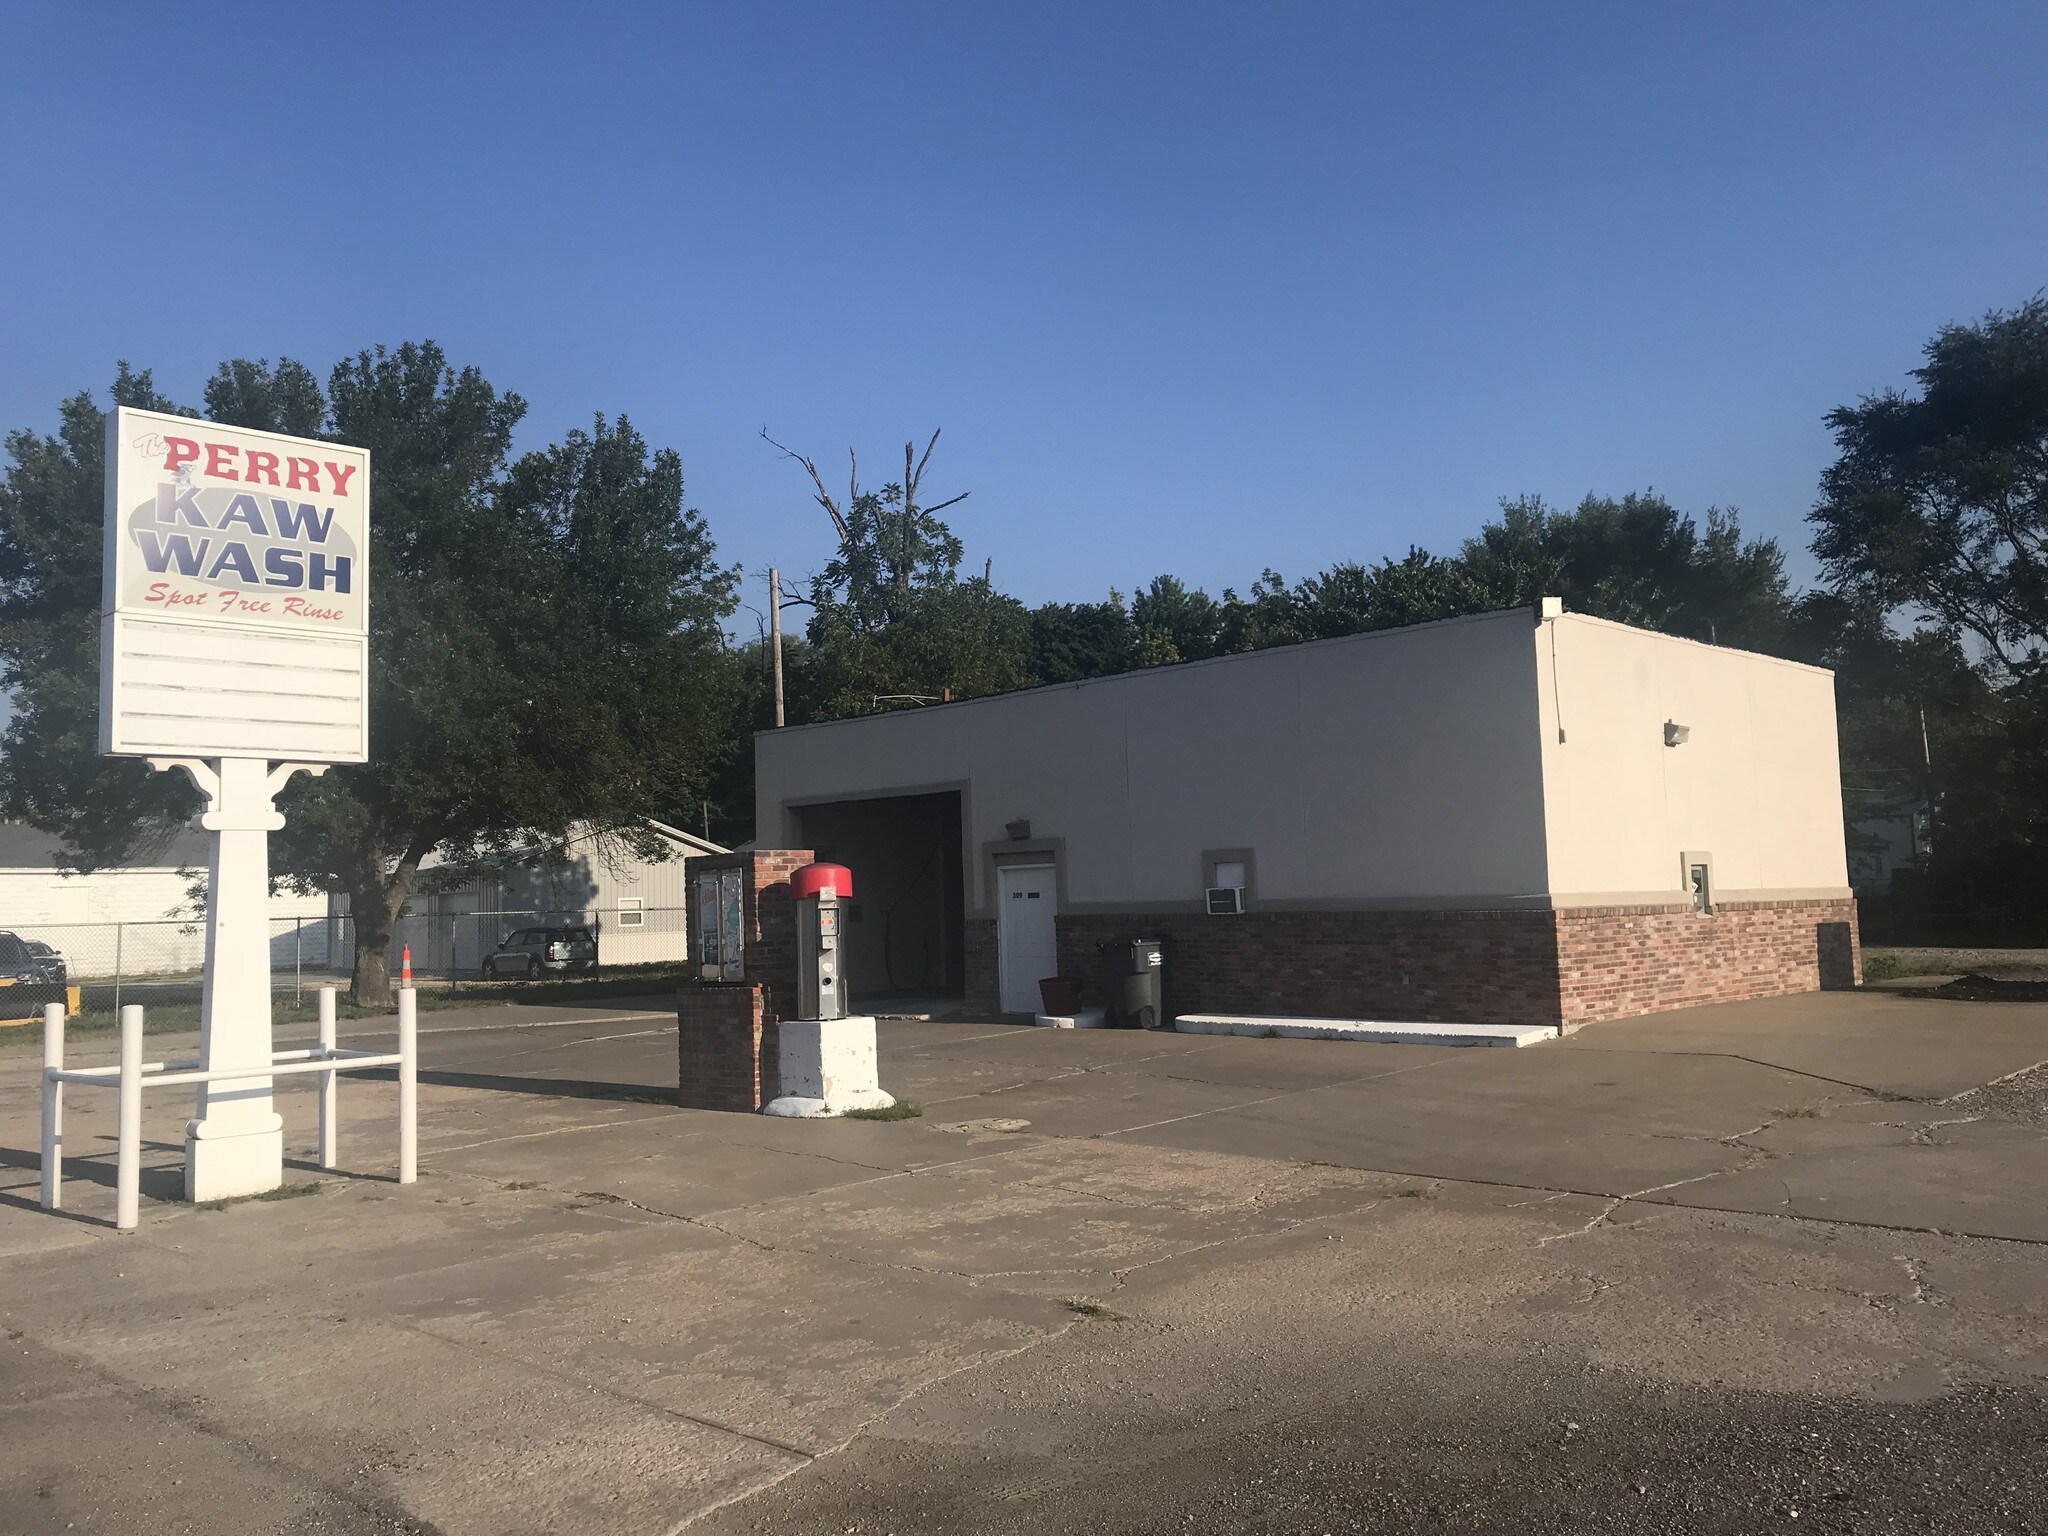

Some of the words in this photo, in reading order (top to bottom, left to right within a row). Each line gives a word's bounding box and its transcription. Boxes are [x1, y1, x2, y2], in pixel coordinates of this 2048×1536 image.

[133, 432, 170, 459] The
[163, 436, 356, 497] PERRY
[155, 482, 335, 544] KAW
[134, 529, 352, 594] WASH
[144, 582, 208, 607] Spot
[218, 590, 273, 613] Free
[281, 596, 345, 621] Rinse
